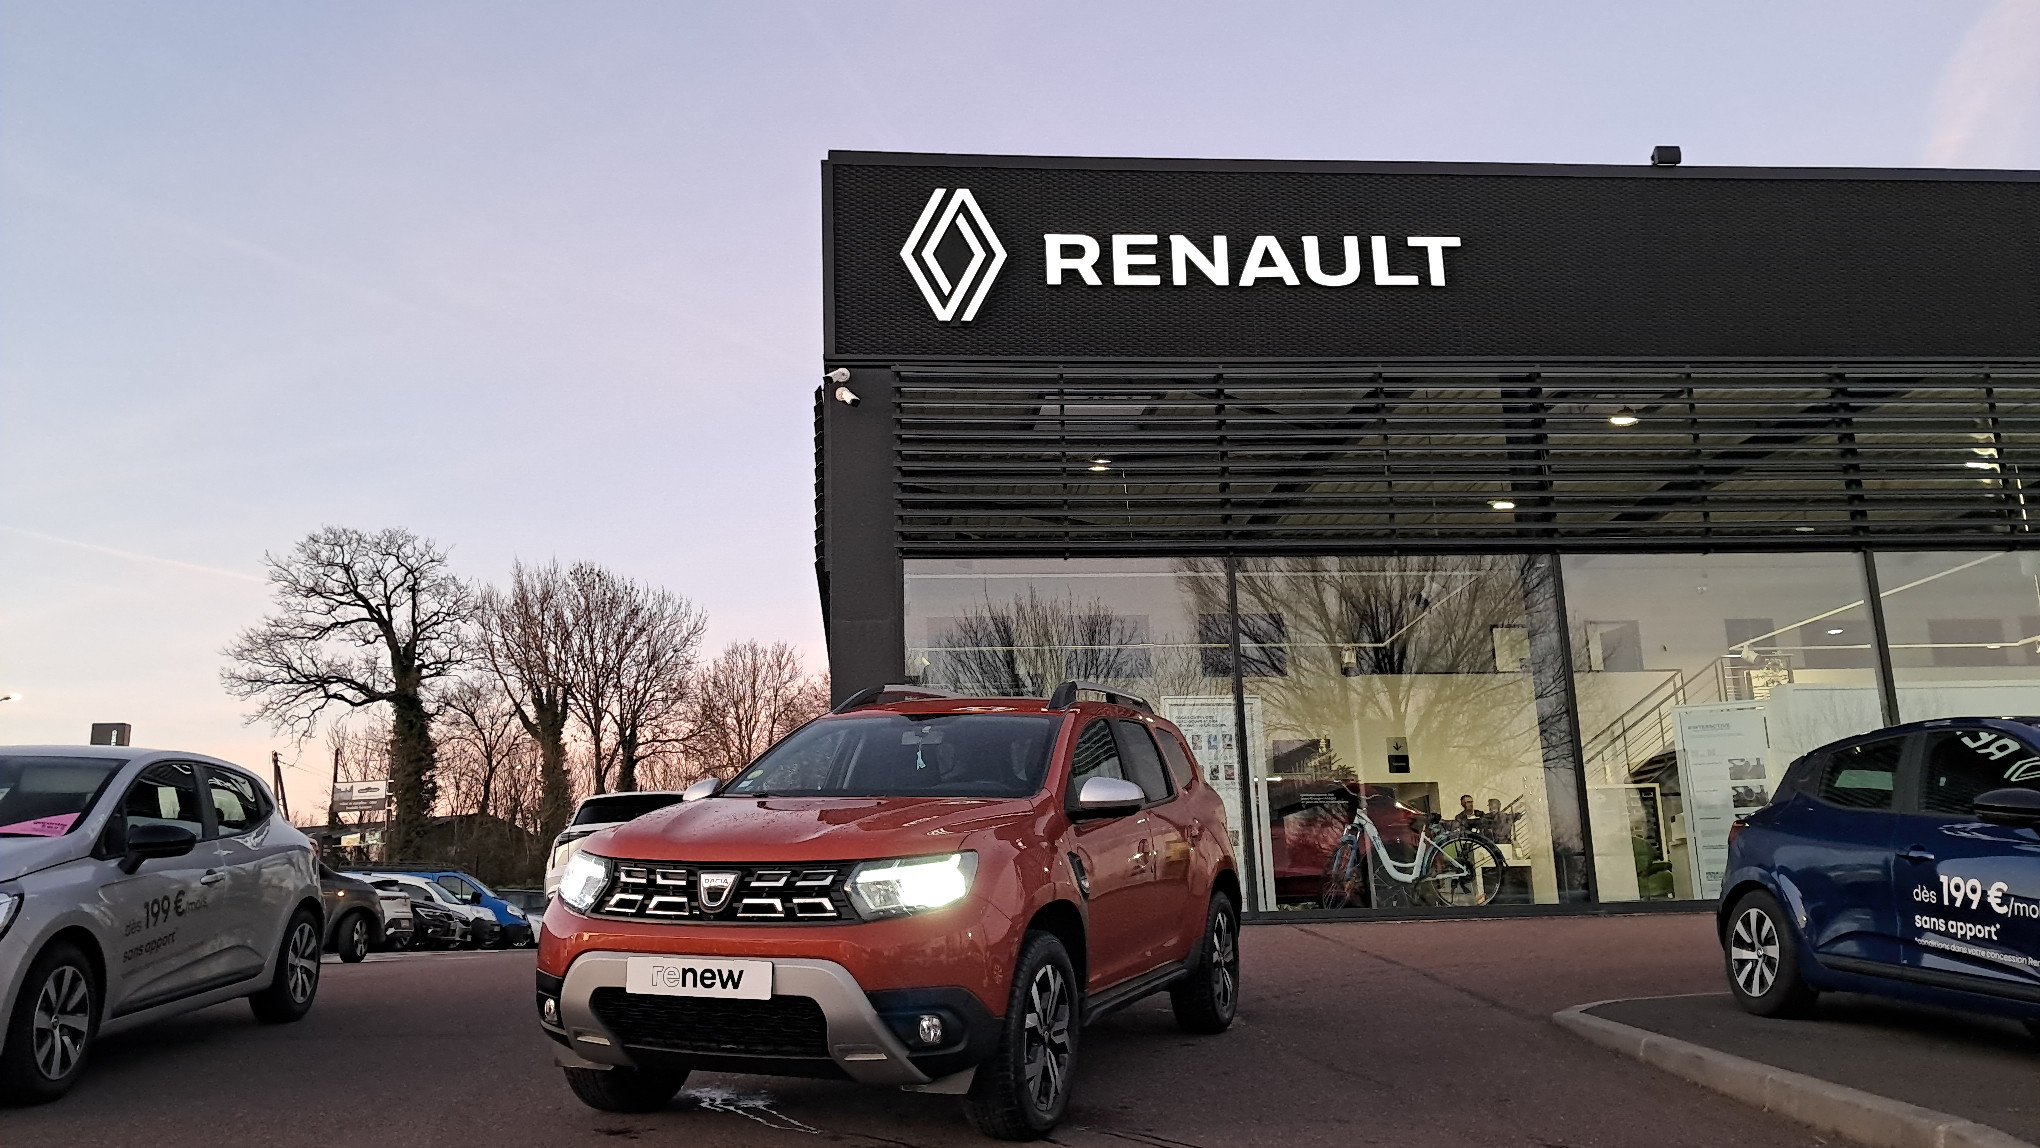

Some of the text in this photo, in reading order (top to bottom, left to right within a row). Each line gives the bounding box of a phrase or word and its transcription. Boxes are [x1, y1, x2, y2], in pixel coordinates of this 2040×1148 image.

[1043, 234, 1461, 287] RENAULT
[1913, 874, 2040, 918] dès 199 €/mo
[144, 895, 170, 929] 199
[1914, 914, 1946, 931] sans
[122, 944, 144, 963] sans
[1950, 943, 1967, 954] dans
[1968, 947, 1985, 957] votre
[1986, 950, 2027, 965] concession
[651, 965, 744, 990] renew
